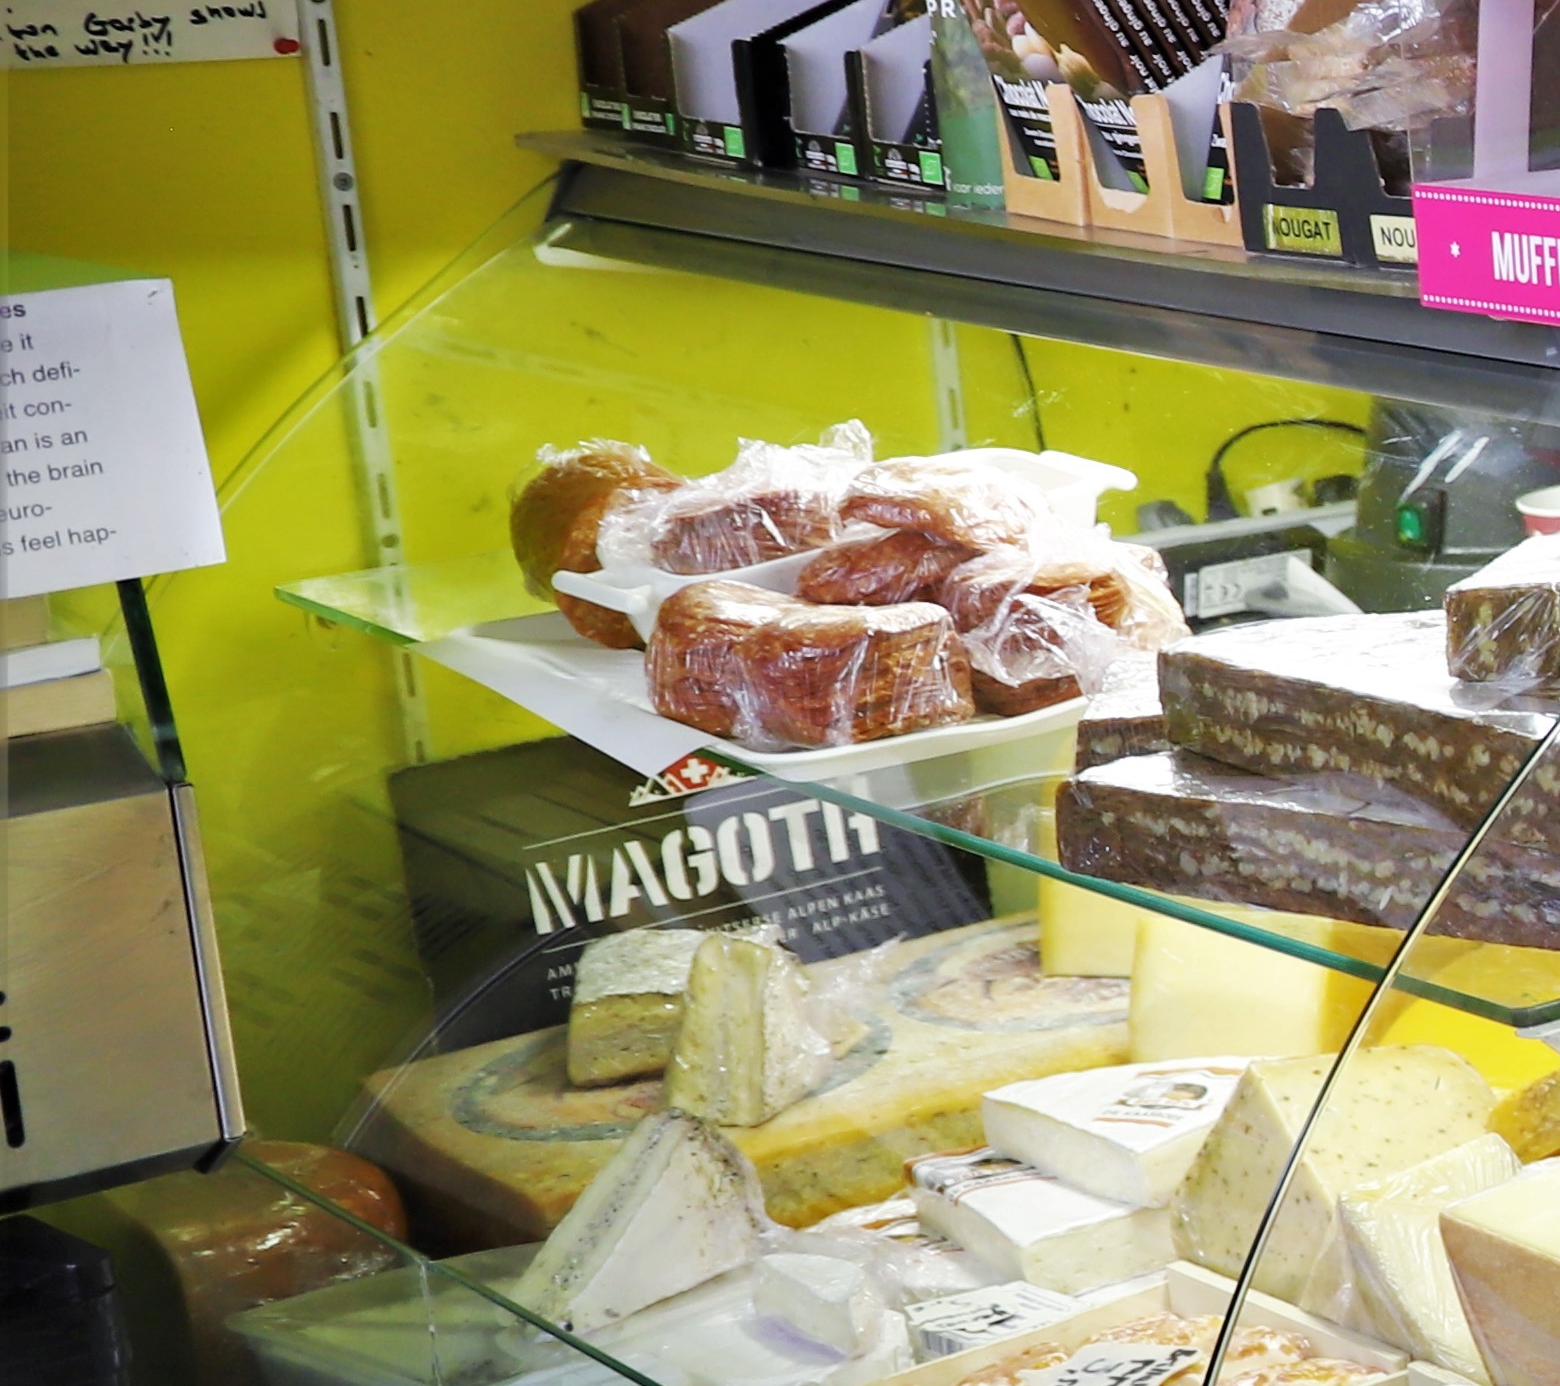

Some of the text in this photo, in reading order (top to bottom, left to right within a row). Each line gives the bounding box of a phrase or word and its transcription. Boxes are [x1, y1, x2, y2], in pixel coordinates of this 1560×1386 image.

[1381, 224, 1415, 248] NOU
[23, 399, 72, 418] con-
[36, 433, 53, 449] is
[61, 429, 88, 447] an
[7, 460, 103, 487] the brain
[21, 527, 117, 553] feel hap-
[788, 899, 840, 922] ALPEN
